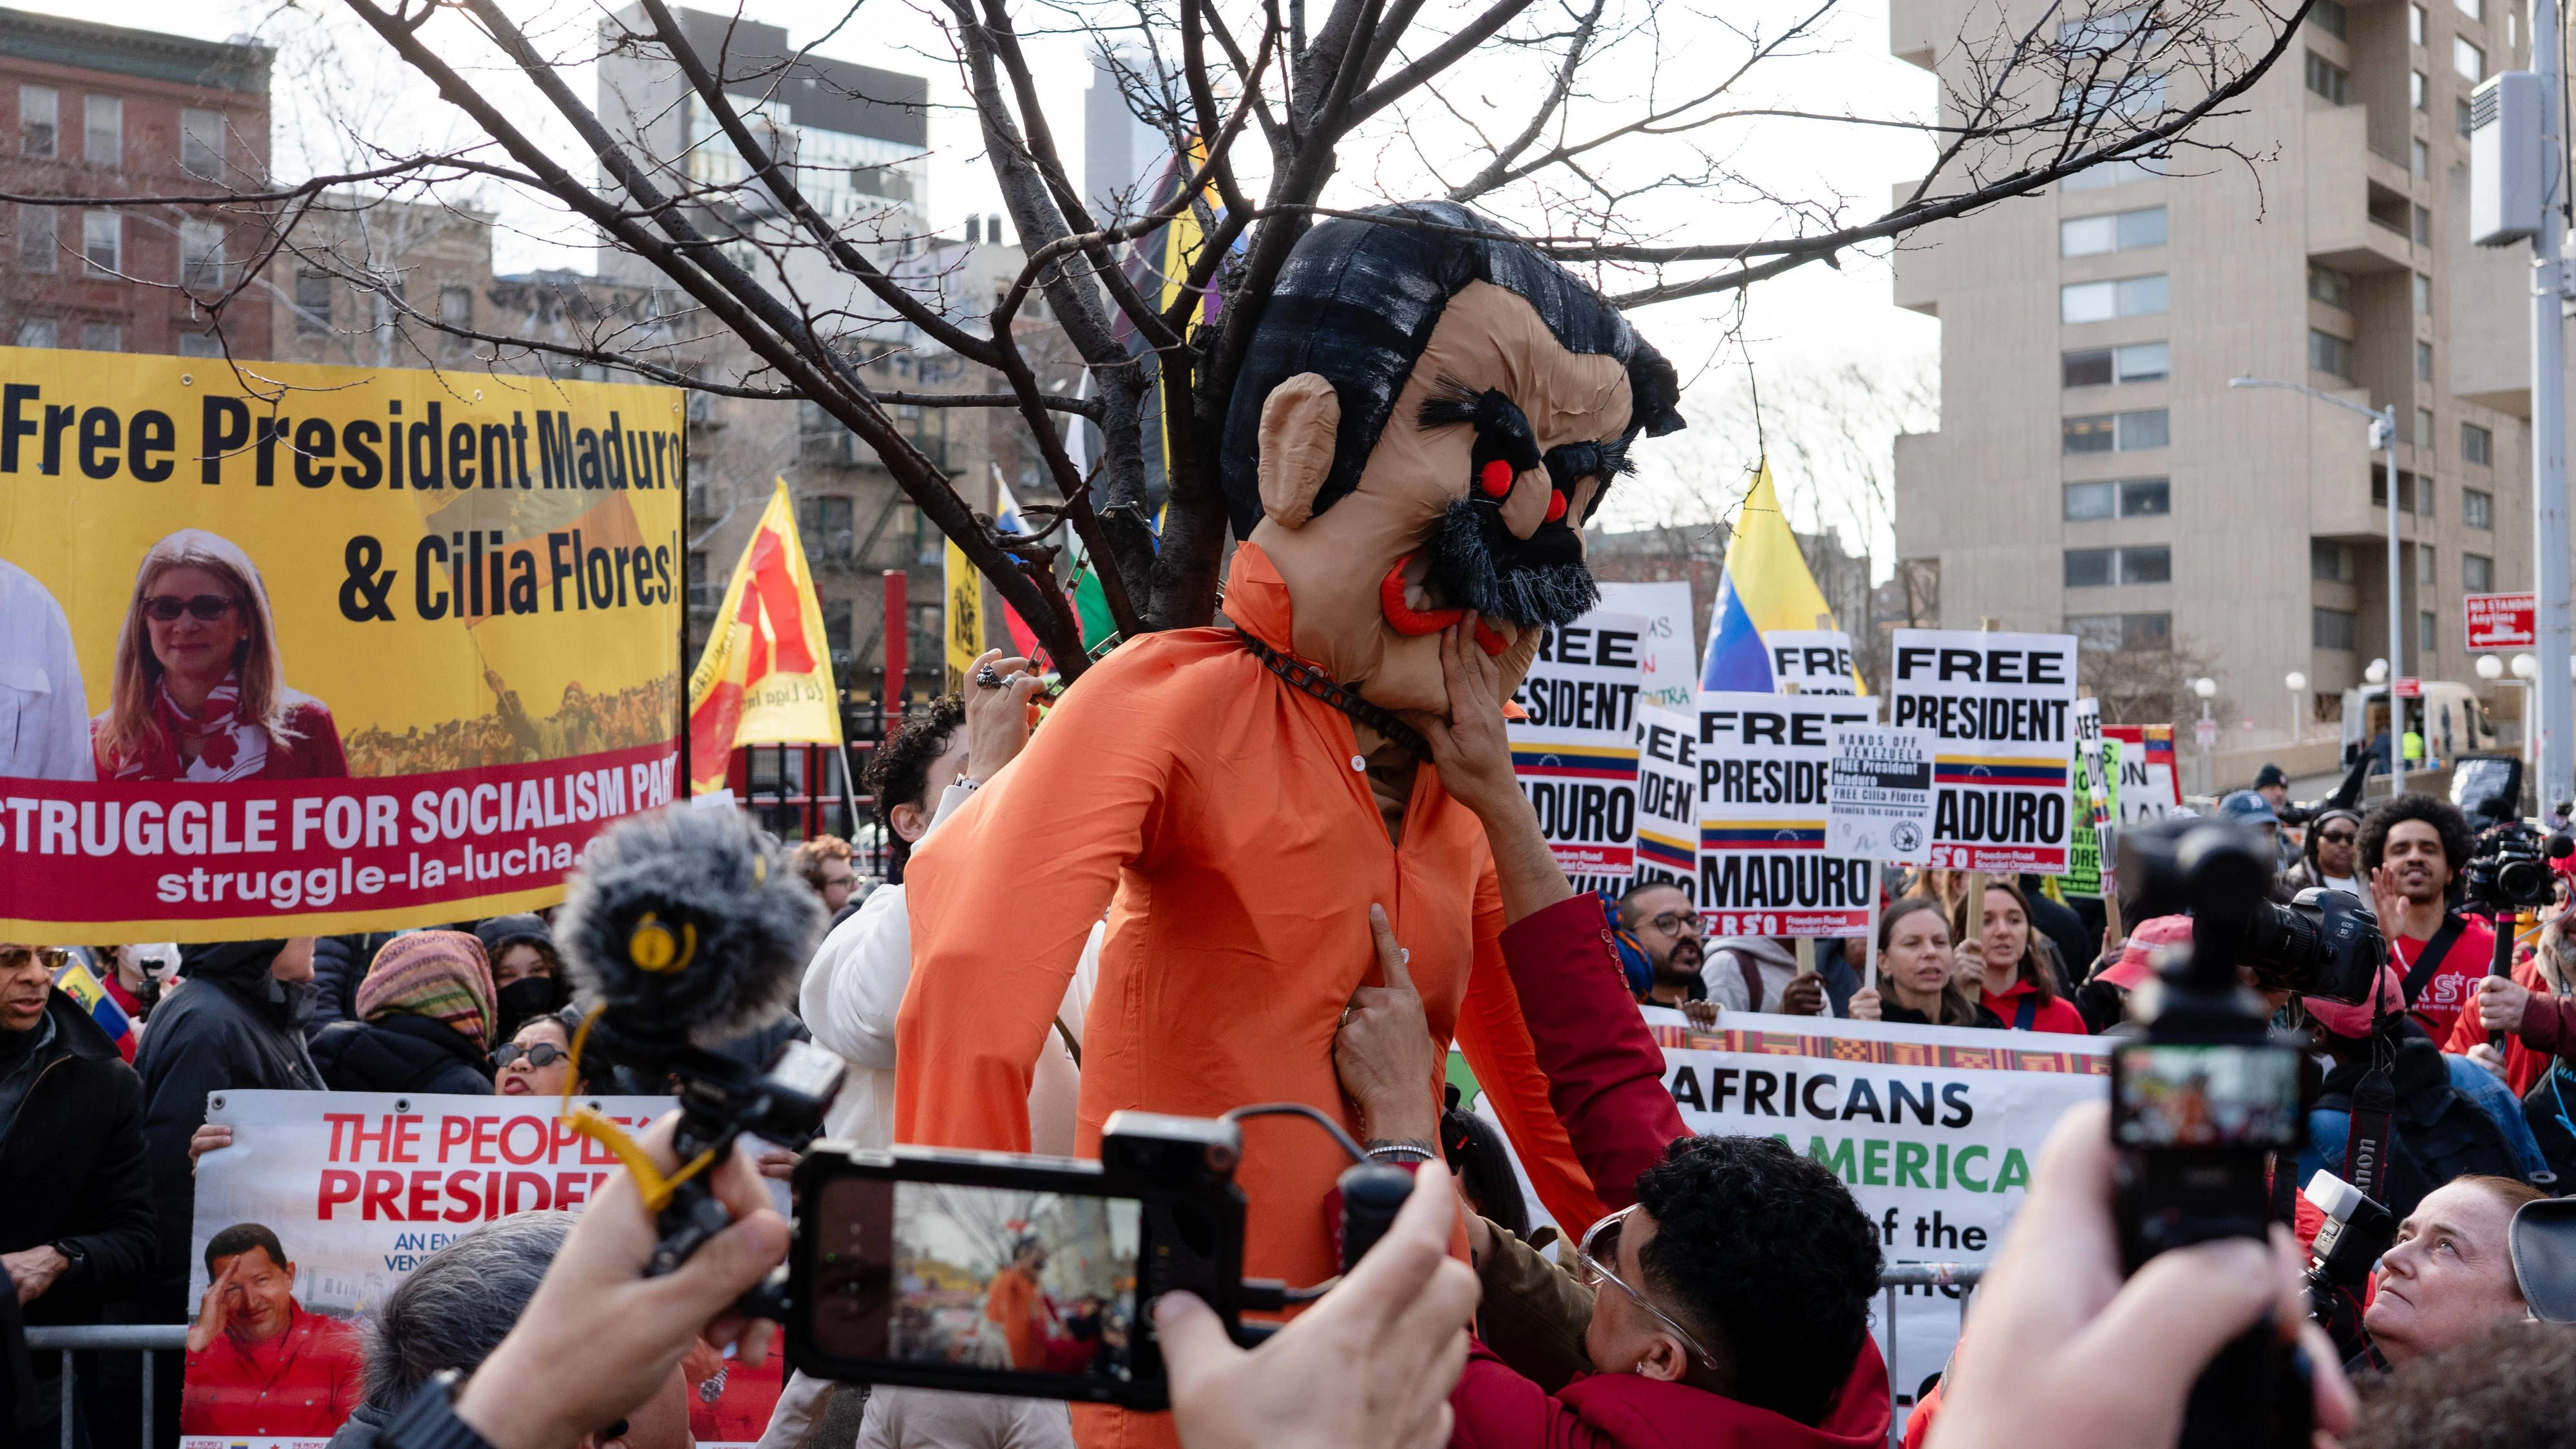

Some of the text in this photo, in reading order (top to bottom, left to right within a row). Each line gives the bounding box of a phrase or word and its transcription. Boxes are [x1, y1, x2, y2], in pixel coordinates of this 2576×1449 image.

[1, 383, 681, 490] Free President Maduro
[339, 528, 677, 621] & Cilia Flores!
[2470, 598, 2534, 613] NO STANDIN
[2471, 612, 2517, 627] Anytime
[1898, 647, 2065, 685] FREE
[1896, 695, 2070, 743] PRESIDENT
[1839, 734, 1917, 748] HANDS OFF
[1844, 747, 1922, 761] VENEZUELA
[1833, 773, 1879, 787] Maduro
[1834, 760, 1918, 776] FREE President
[292, 795, 399, 850] FOR
[411, 766, 627, 844] SOCIALISM
[1834, 788, 1926, 803] FREE Cilia Flores
[1519, 781, 1635, 843] DURO
[1868, 807, 1881, 816] the
[1580, 850, 1604, 862] Road
[2011, 851, 2036, 862] Road
[1701, 855, 1871, 909] MADURO
[1823, 915, 1847, 925] Road
[1672, 1066, 1974, 1128] AFRICANS
[323, 1113, 422, 1163] THE
[1772, 1133, 2032, 1194] MERICA
[317, 1169, 608, 1222] PRESIDE
[393, 1232, 425, 1251] AN
[1914, 1210, 1987, 1251] the
